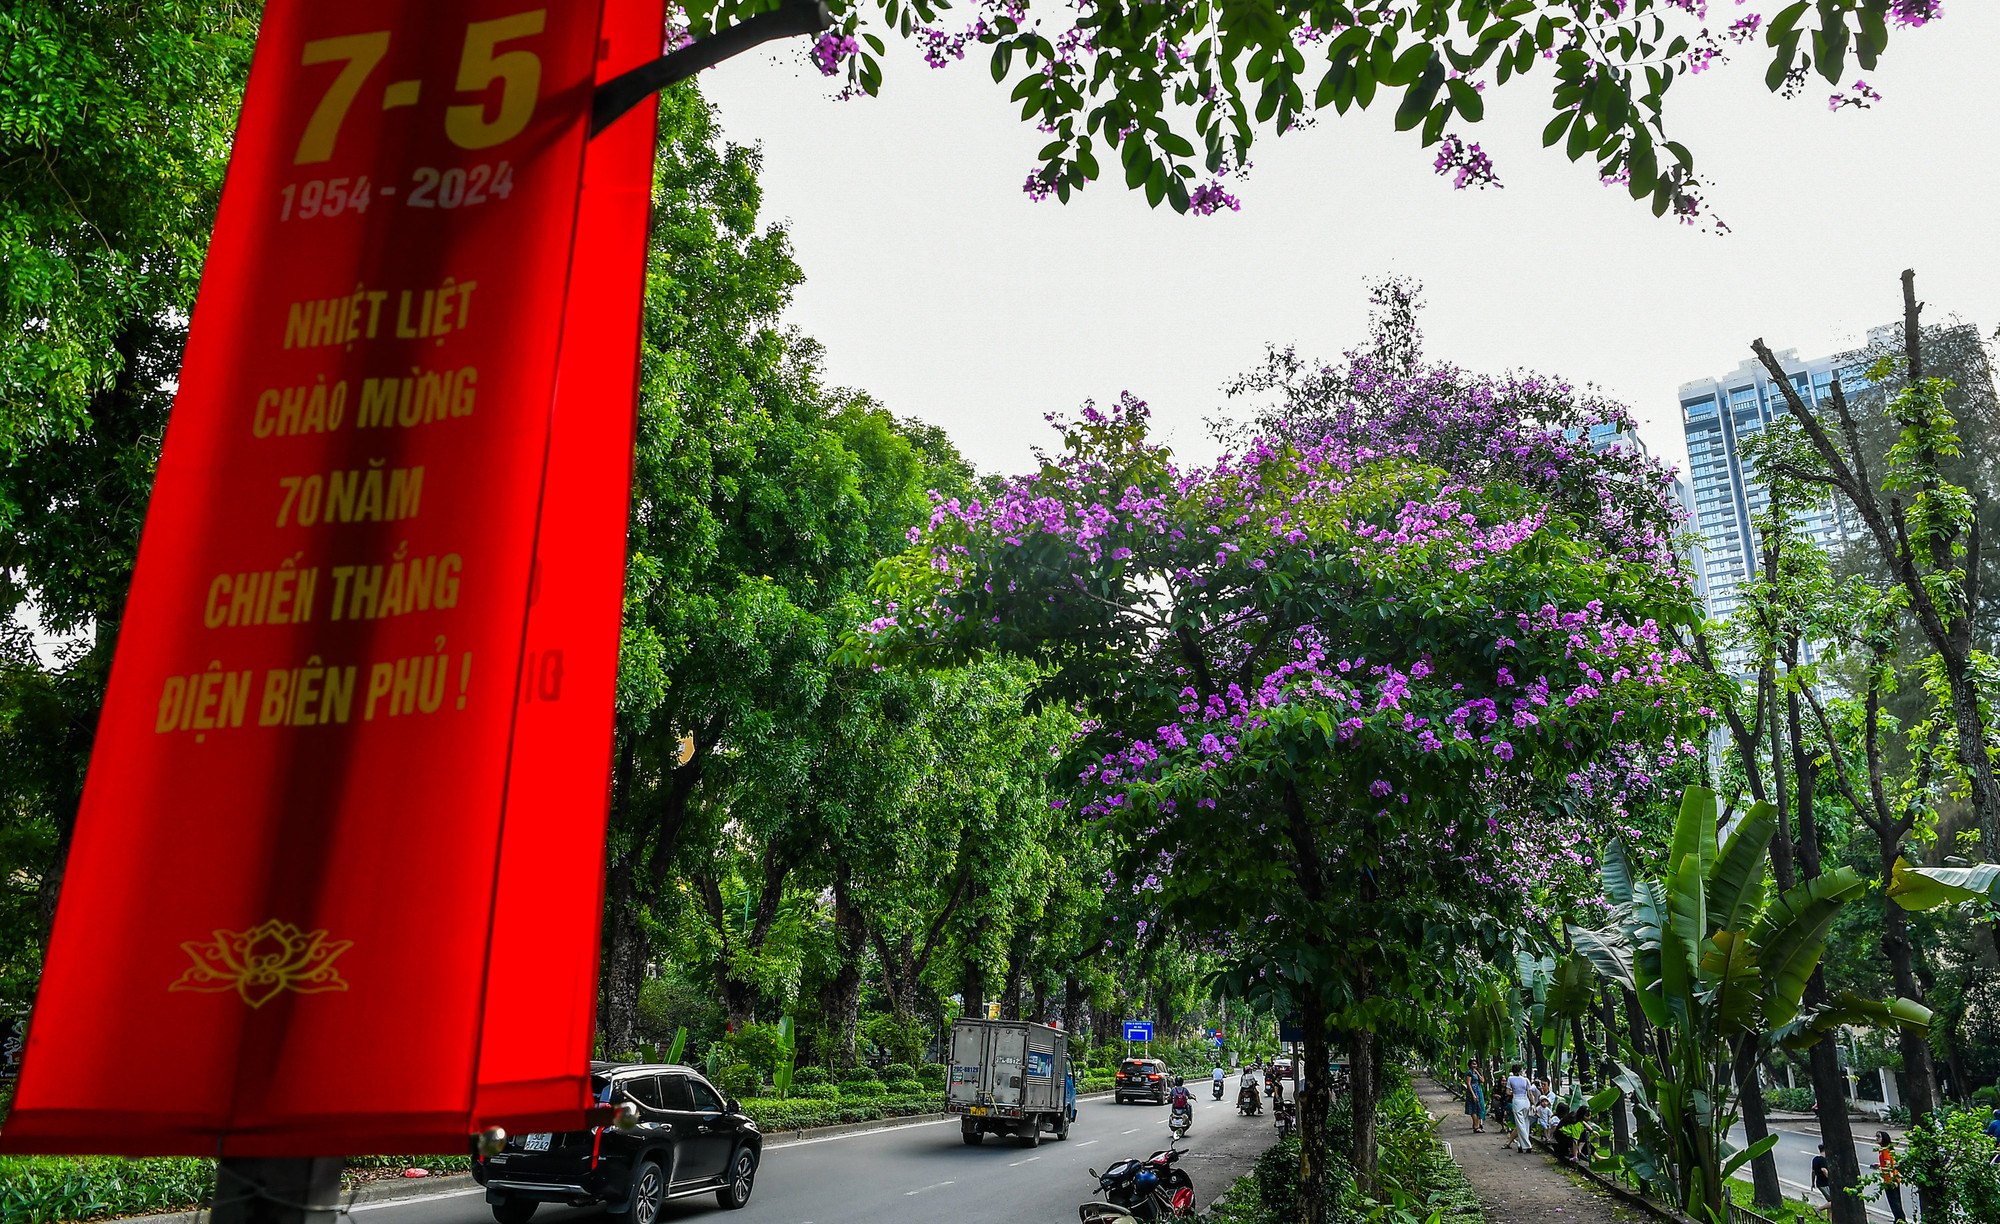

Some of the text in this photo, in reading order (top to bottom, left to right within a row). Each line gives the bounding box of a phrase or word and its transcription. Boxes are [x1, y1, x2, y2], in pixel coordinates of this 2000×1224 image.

[281, 176, 370, 221] 1954
[407, 161, 513, 208] 2024
[284, 277, 477, 351] NHIỆT LIỆT
[253, 366, 478, 439] CHÀO MỪNG
[276, 457, 425, 528] 70 NĂM
[204, 540, 462, 629] CHIẾN THẮNG
[155, 660, 253, 743] ĐIỆN
[259, 656, 356, 727] BIÊN
